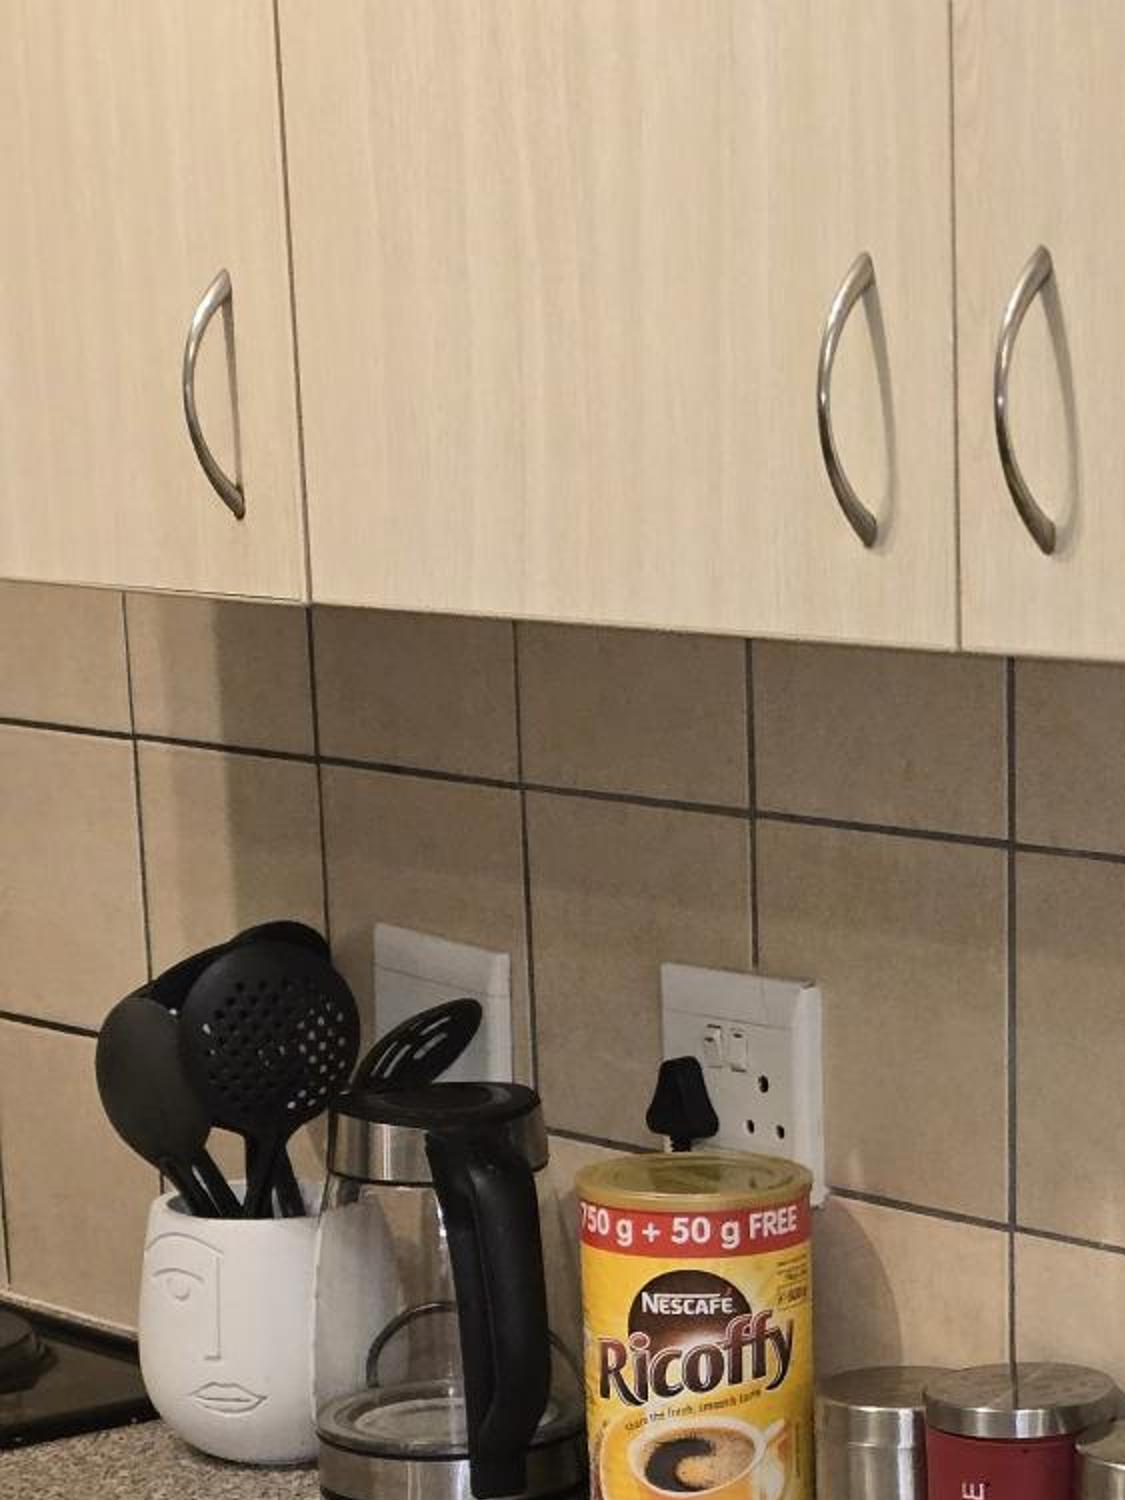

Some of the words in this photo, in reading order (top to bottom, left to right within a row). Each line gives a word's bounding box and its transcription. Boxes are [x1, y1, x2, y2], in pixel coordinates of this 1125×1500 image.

[615, 1219, 633, 1247] g
[642, 1222, 660, 1243] +
[671, 1217, 711, 1244] 50
[720, 1221, 741, 1249] g
[749, 1206, 798, 1240] FREE
[597, 1309, 794, 1407] Ricoffy
